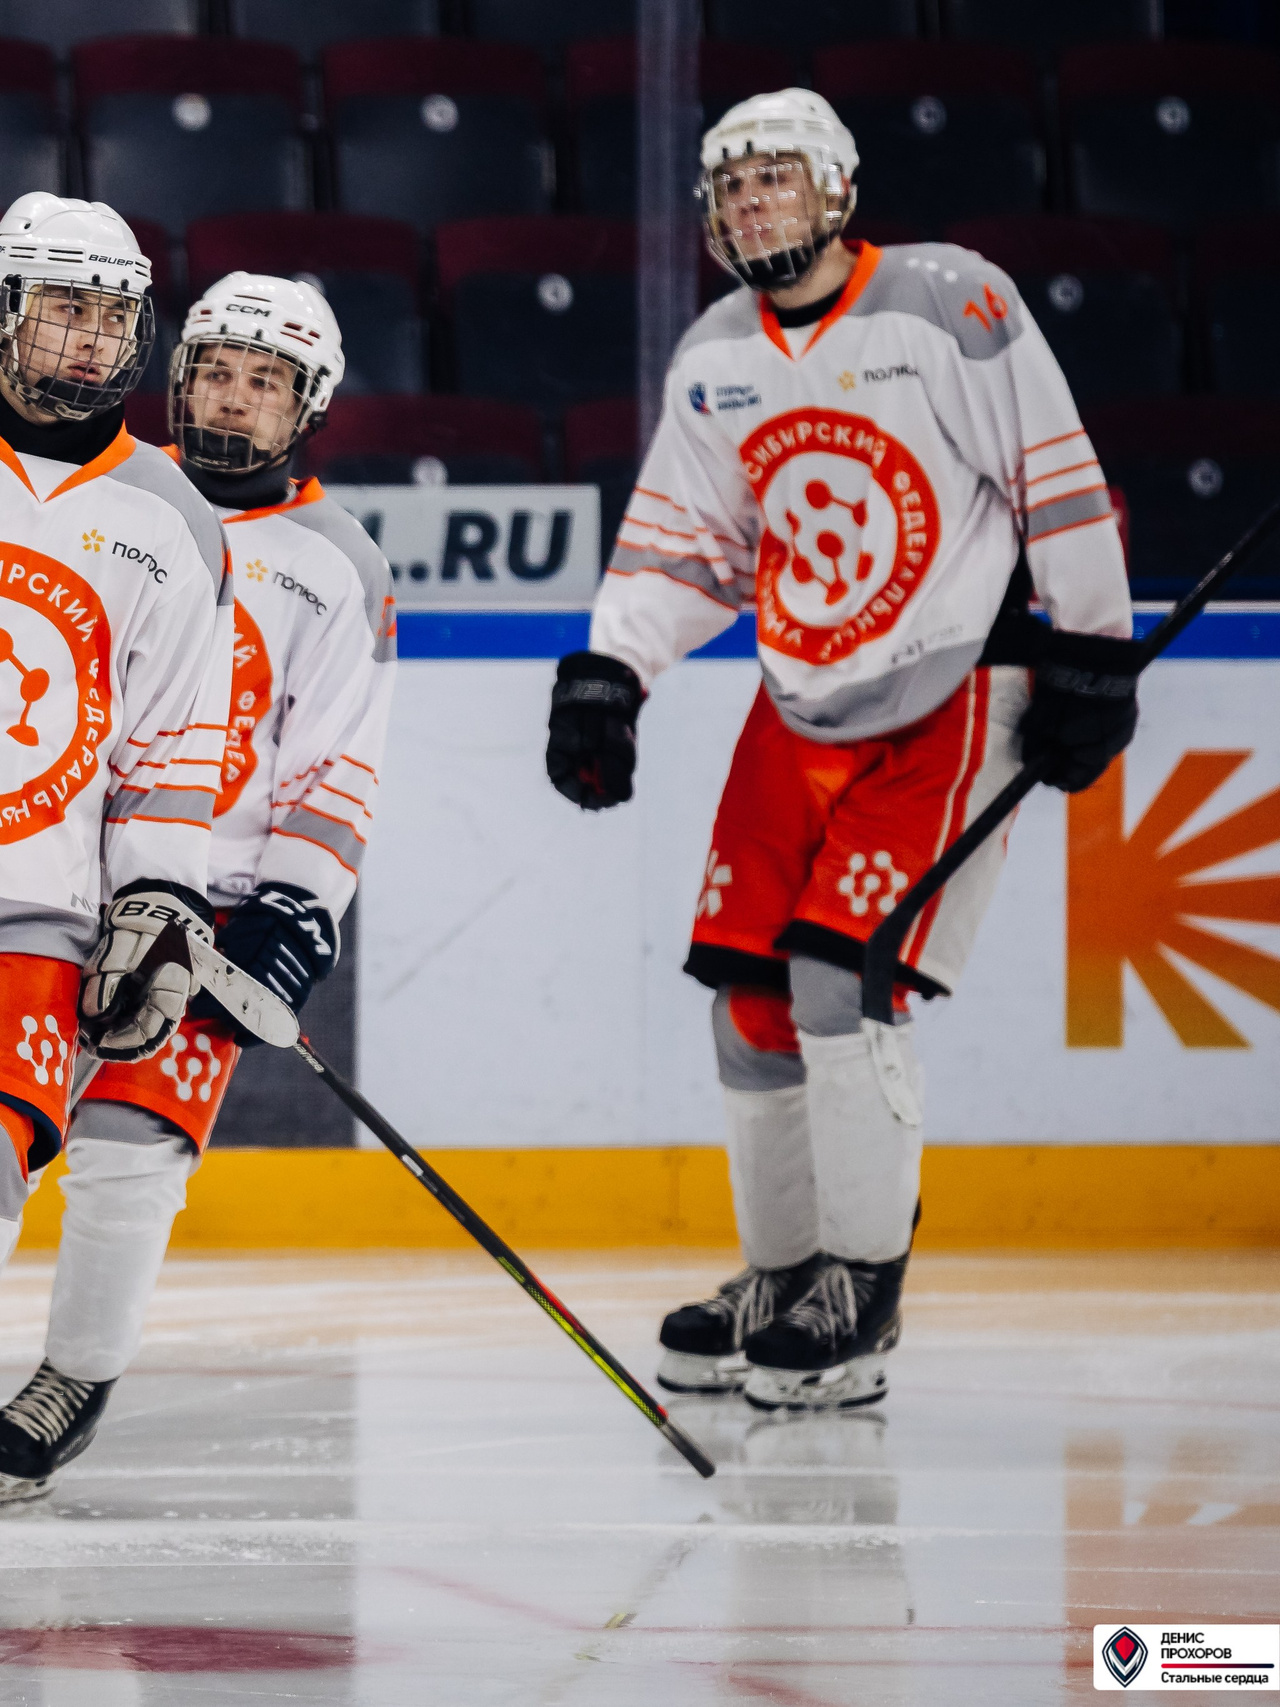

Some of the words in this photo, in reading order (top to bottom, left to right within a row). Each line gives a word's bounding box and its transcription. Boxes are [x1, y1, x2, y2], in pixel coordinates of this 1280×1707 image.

[88, 253, 134, 268] BAUER
[225, 303, 272, 318] CCM
[963, 283, 1009, 333] 16
